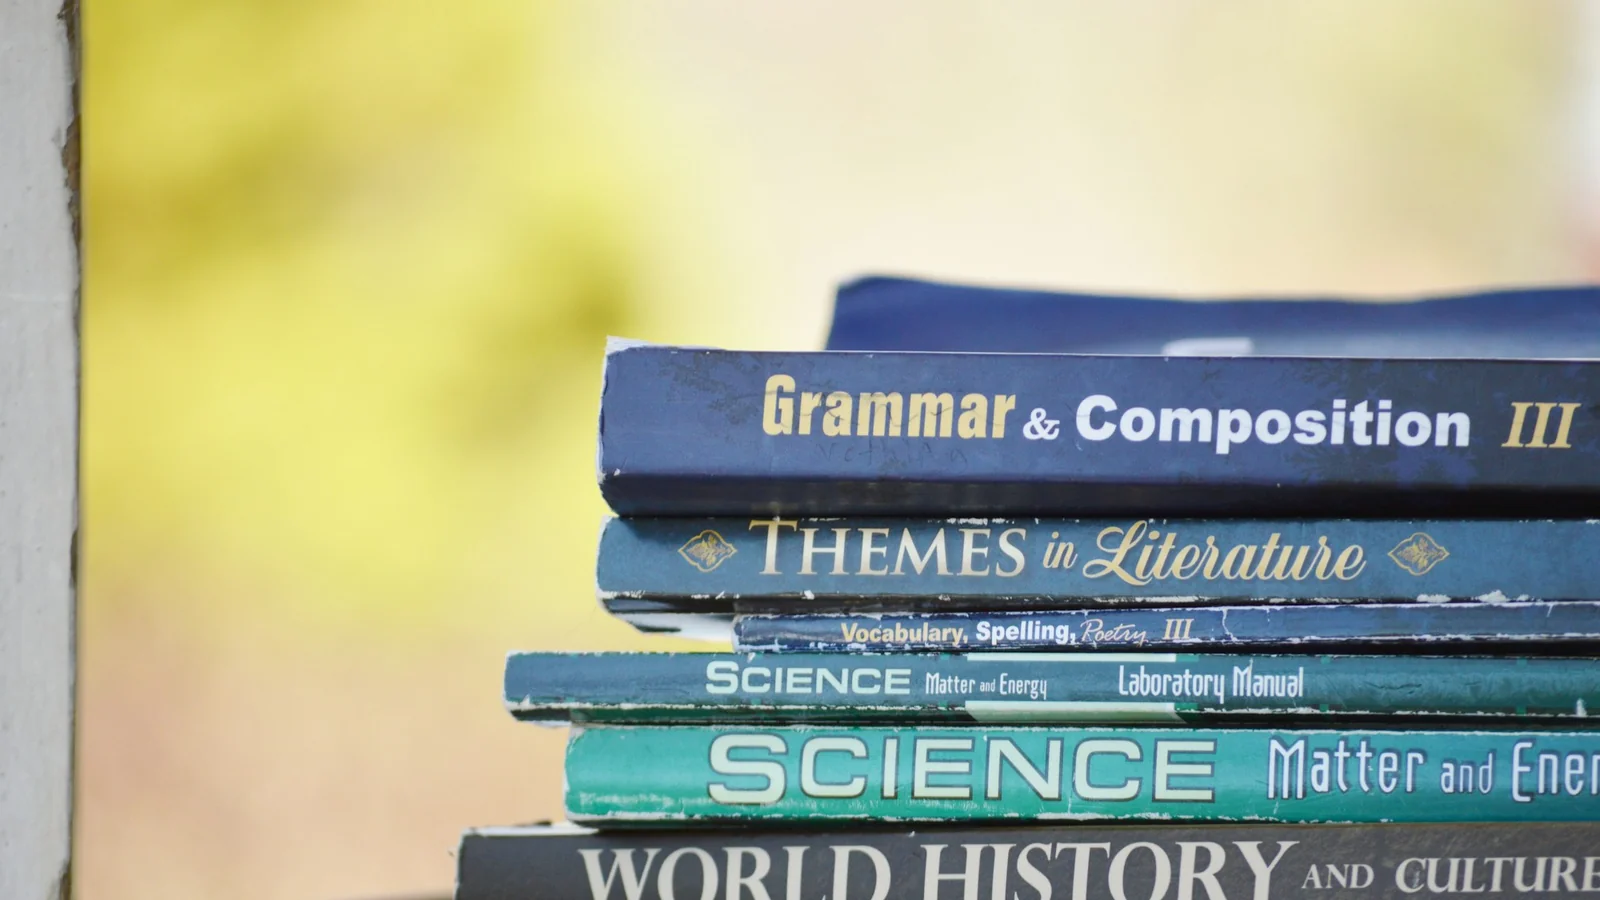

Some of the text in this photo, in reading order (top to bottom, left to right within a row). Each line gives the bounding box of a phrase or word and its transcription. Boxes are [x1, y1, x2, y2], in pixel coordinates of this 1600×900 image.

[762, 374, 1582, 455] Grammar & Composition III
[749, 519, 1366, 586] THEMES in Literature
[841, 618, 1194, 648] Vocabulary, Spelling, Poetry III
[706, 661, 1048, 700] SCIENCE Matter and Energy
[1118, 664, 1304, 706] Laboratory Manual
[707, 732, 1216, 806] SCIENCE
[1267, 739, 1425, 799] Matter
[1440, 752, 1493, 794] and
[578, 846, 892, 900] WORLD
[920, 840, 1299, 900] HISTORY
[1302, 863, 1375, 889] AND
